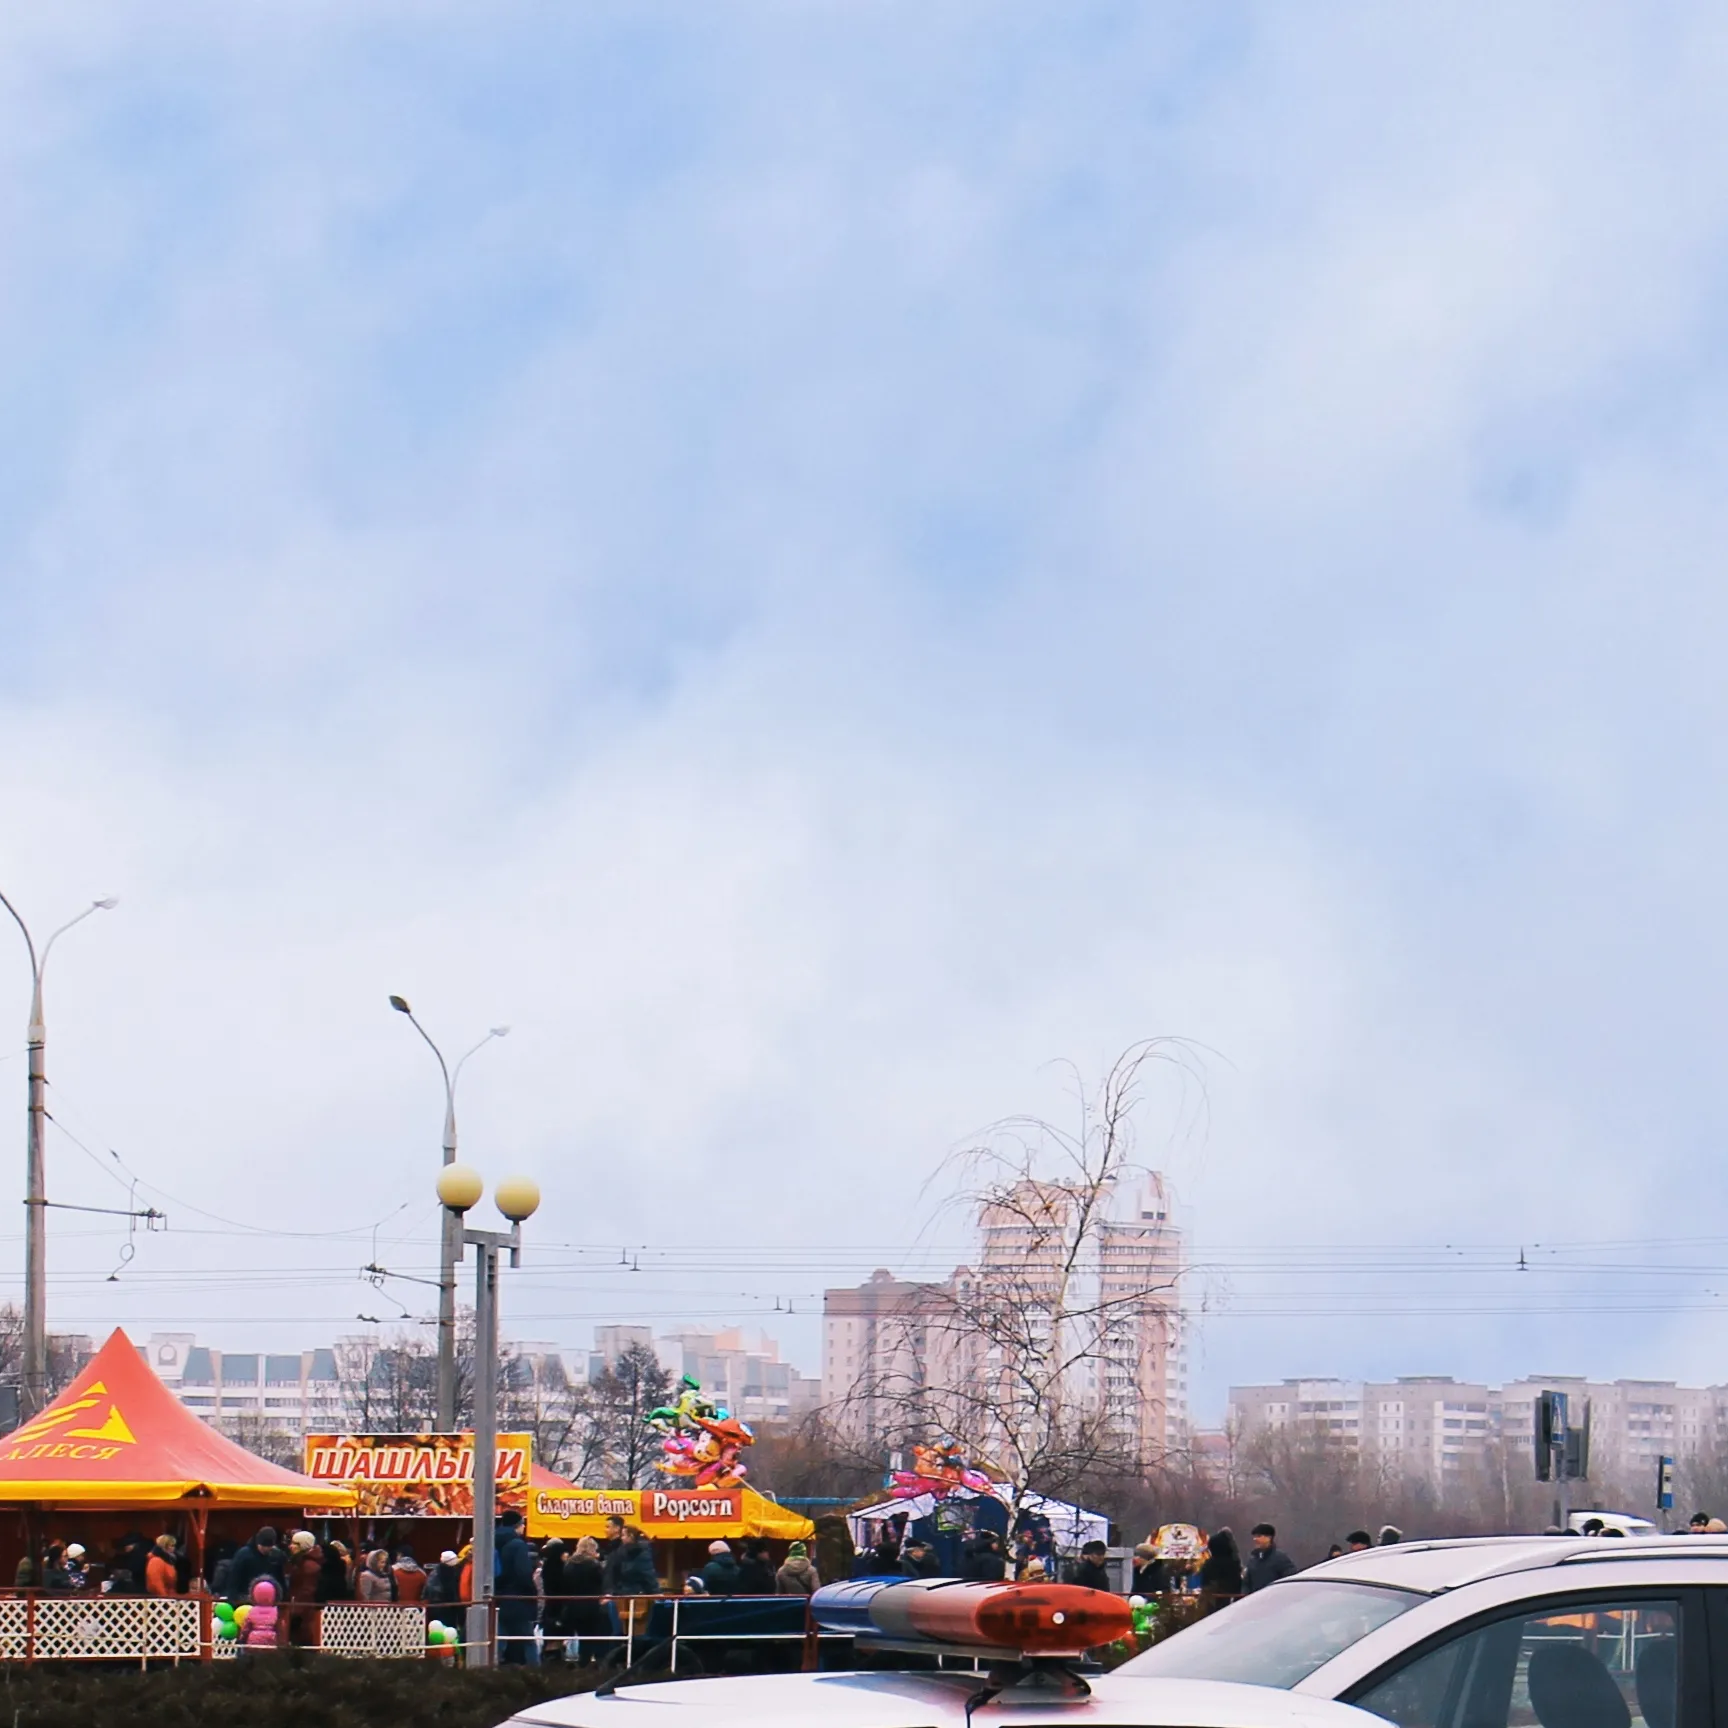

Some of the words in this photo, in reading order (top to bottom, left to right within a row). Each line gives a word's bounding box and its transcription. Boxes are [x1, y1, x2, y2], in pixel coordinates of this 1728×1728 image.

[311, 1449, 523, 1481] ШАШЛЫИ
[536, 1492, 596, 1519] Сладкая
[597, 1493, 634, 1514] вата
[653, 1492, 733, 1521] Popcorn
